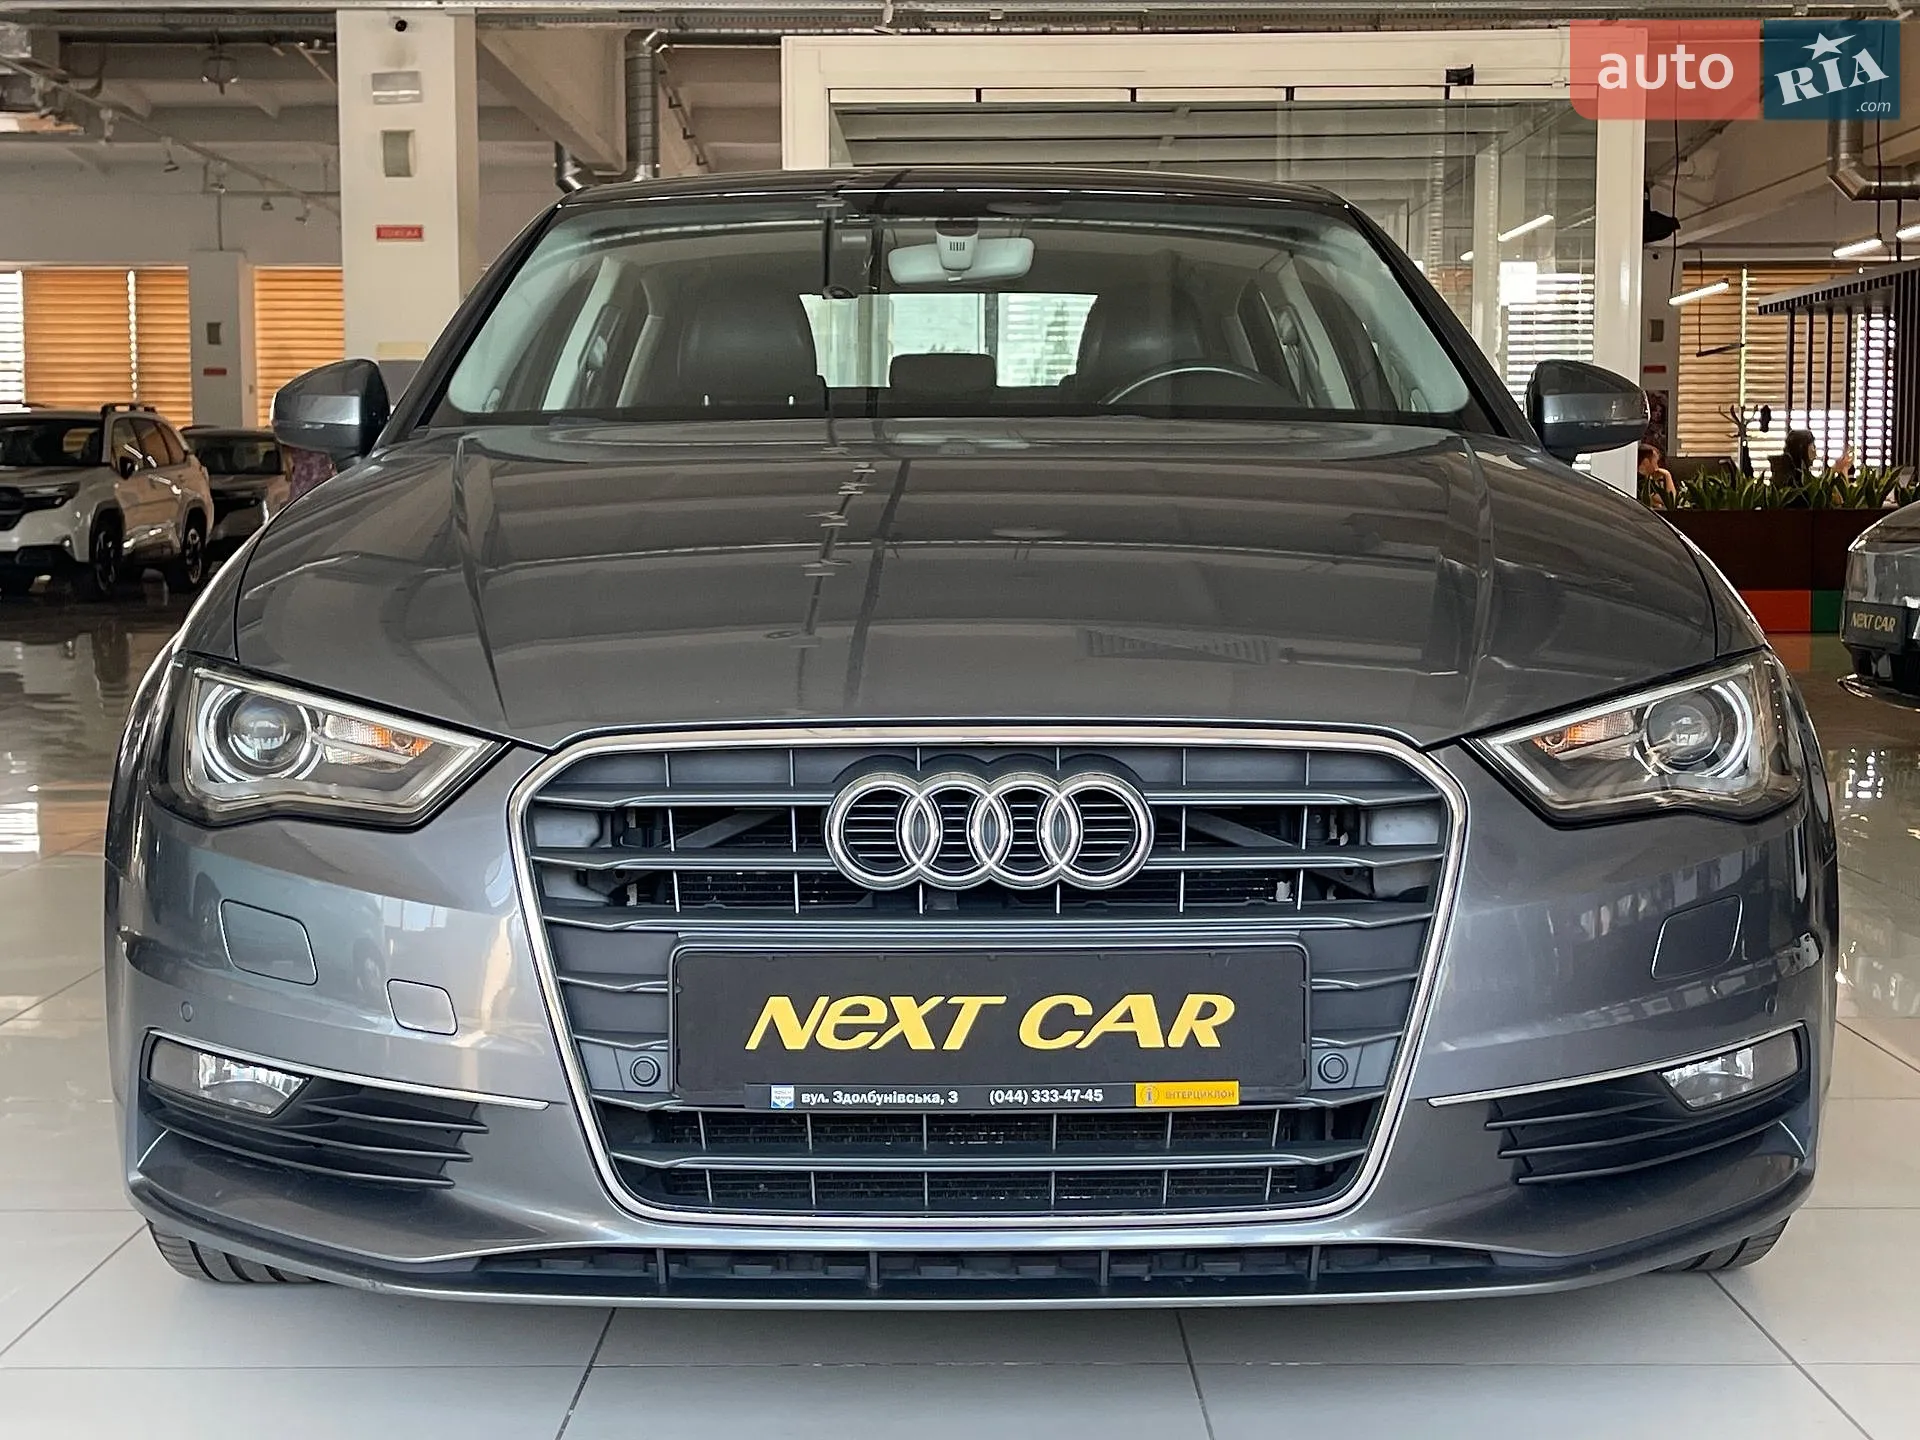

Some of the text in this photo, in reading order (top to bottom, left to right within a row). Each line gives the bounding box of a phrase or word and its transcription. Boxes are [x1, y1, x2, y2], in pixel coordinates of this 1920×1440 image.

[1874, 615, 1897, 633] CAR
[1018, 994, 1236, 1050] CAR
[801, 1092, 830, 1106] вул.
[832, 1090, 945, 1106] Здолбунівська,
[948, 1090, 959, 1104] 3
[989, 1089, 1029, 1106] (044)
[1031, 1088, 1104, 1103] 333-47-45
[1165, 1089, 1236, 1100] ІНТЕРЦИКЛОН
